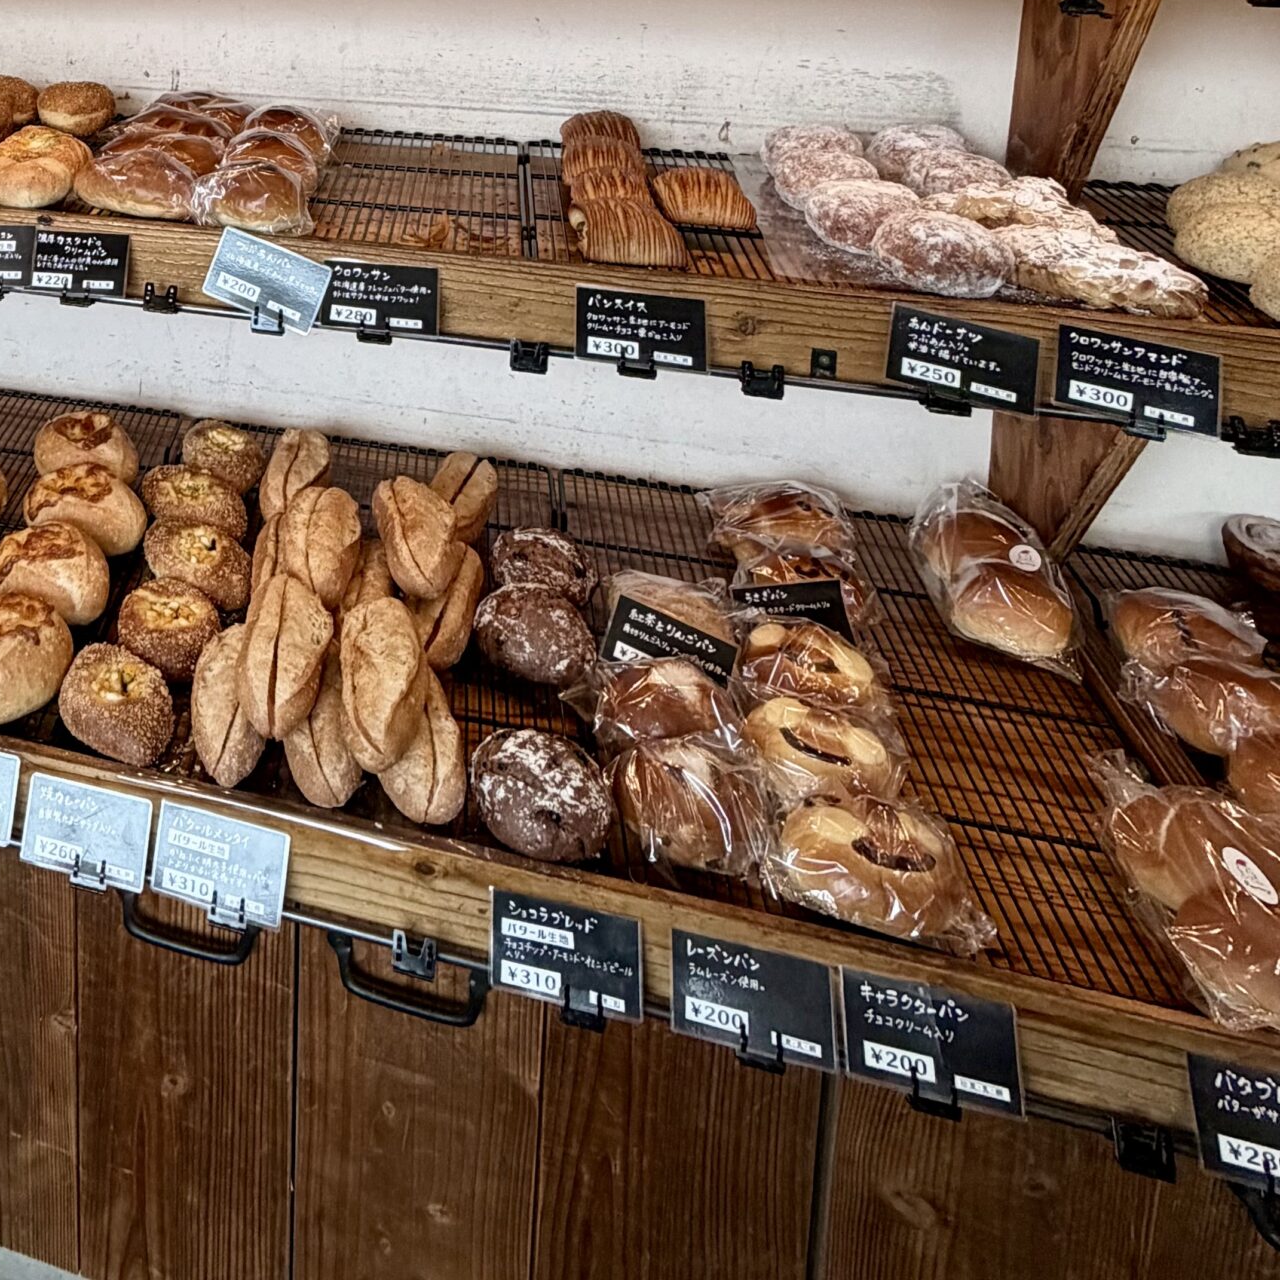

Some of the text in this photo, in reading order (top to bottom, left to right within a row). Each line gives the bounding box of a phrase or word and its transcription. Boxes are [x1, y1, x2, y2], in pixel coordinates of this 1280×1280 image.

[36, 274, 69, 286] ¥220
[333, 265, 391, 281] クロワッサン
[221, 275, 257, 298] ¥200
[335, 307, 372, 322] ¥280
[587, 294, 648, 313] パンスイス
[908, 316, 984, 344] あんドーナツ
[592, 339, 636, 357] ¥300
[1069, 331, 1189, 367] クロワッサンアマンド
[907, 362, 957, 384] ¥250
[1075, 385, 1129, 407] ¥300
[744, 588, 788, 603] うさぎパン
[628, 608, 718, 654] 紅茶とりんごパン
[38, 839, 79, 861] ¥260
[167, 872, 210, 896] ¥310
[508, 900, 600, 934] ショコラブレッド
[506, 922, 570, 946] バタール生地
[686, 938, 761, 972] レーズンパン
[507, 965, 557, 991] ¥310
[860, 980, 970, 1023] キャラクターパン
[690, 1001, 744, 1030] ¥200
[863, 1008, 955, 1044] チョコクリーム入り
[870, 1046, 928, 1077] ¥200
[1226, 1139, 1280, 1172] ¥28
